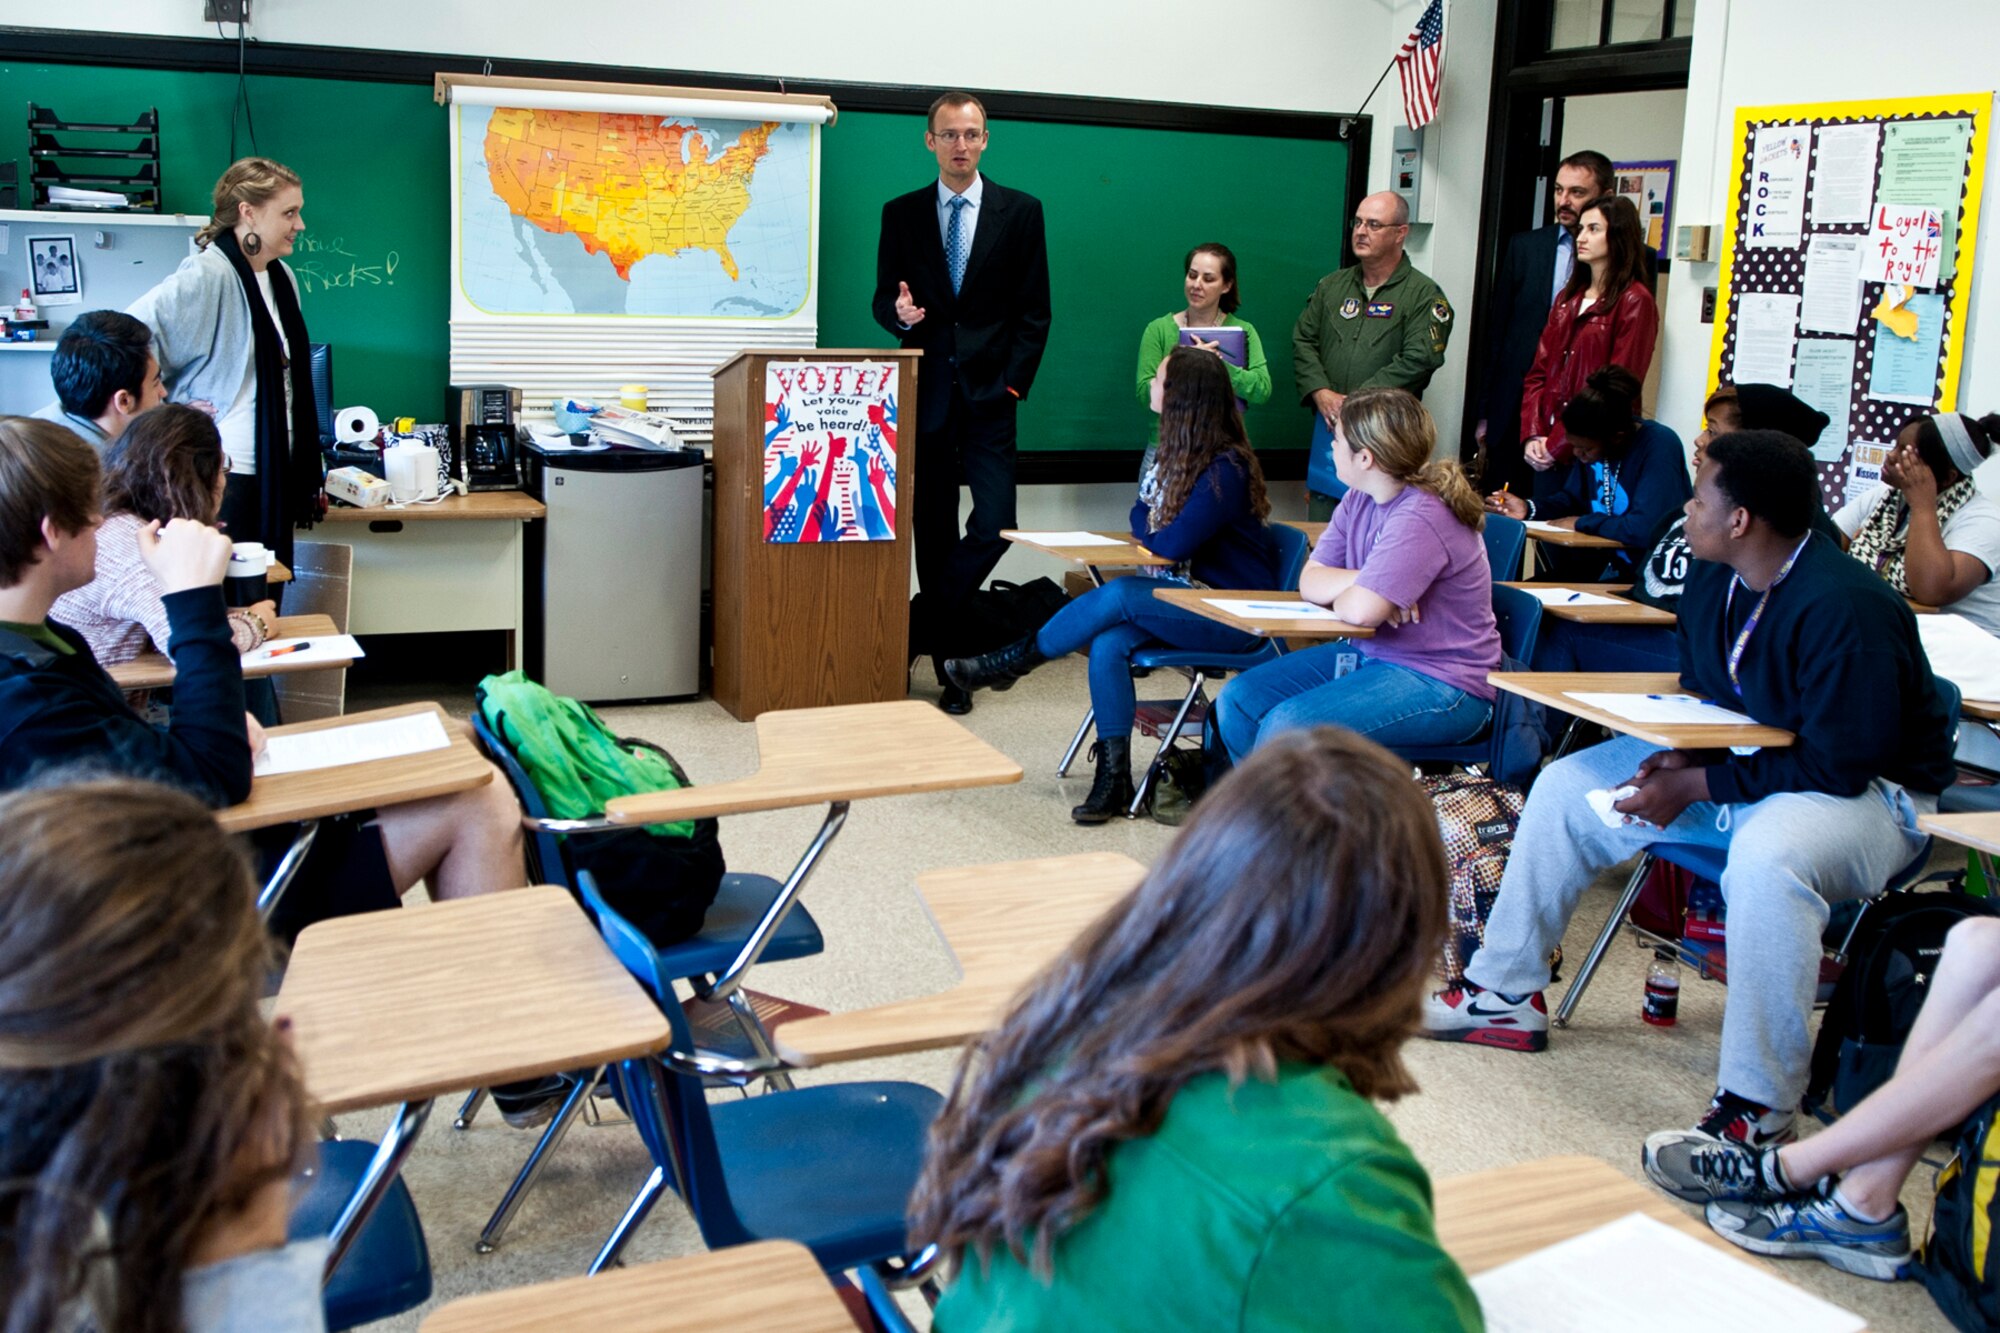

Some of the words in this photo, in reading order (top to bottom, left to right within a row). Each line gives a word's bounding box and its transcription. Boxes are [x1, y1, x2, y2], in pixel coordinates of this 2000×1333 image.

[1761, 137, 1788, 154] YELLOW
[1759, 147, 1789, 164] JACKETS
[1878, 206, 1927, 237] Loyal
[1879, 236, 1898, 258] to
[1912, 238, 1939, 261] the
[1884, 259, 1928, 283] Royal
[769, 365, 897, 402] VOTE!
[802, 397, 824, 407] Let
[828, 397, 863, 406] your
[816, 408, 849, 416] voice
[795, 420, 815, 432] be
[819, 417, 868, 432] heard!
[1855, 466, 1880, 480] Mission
